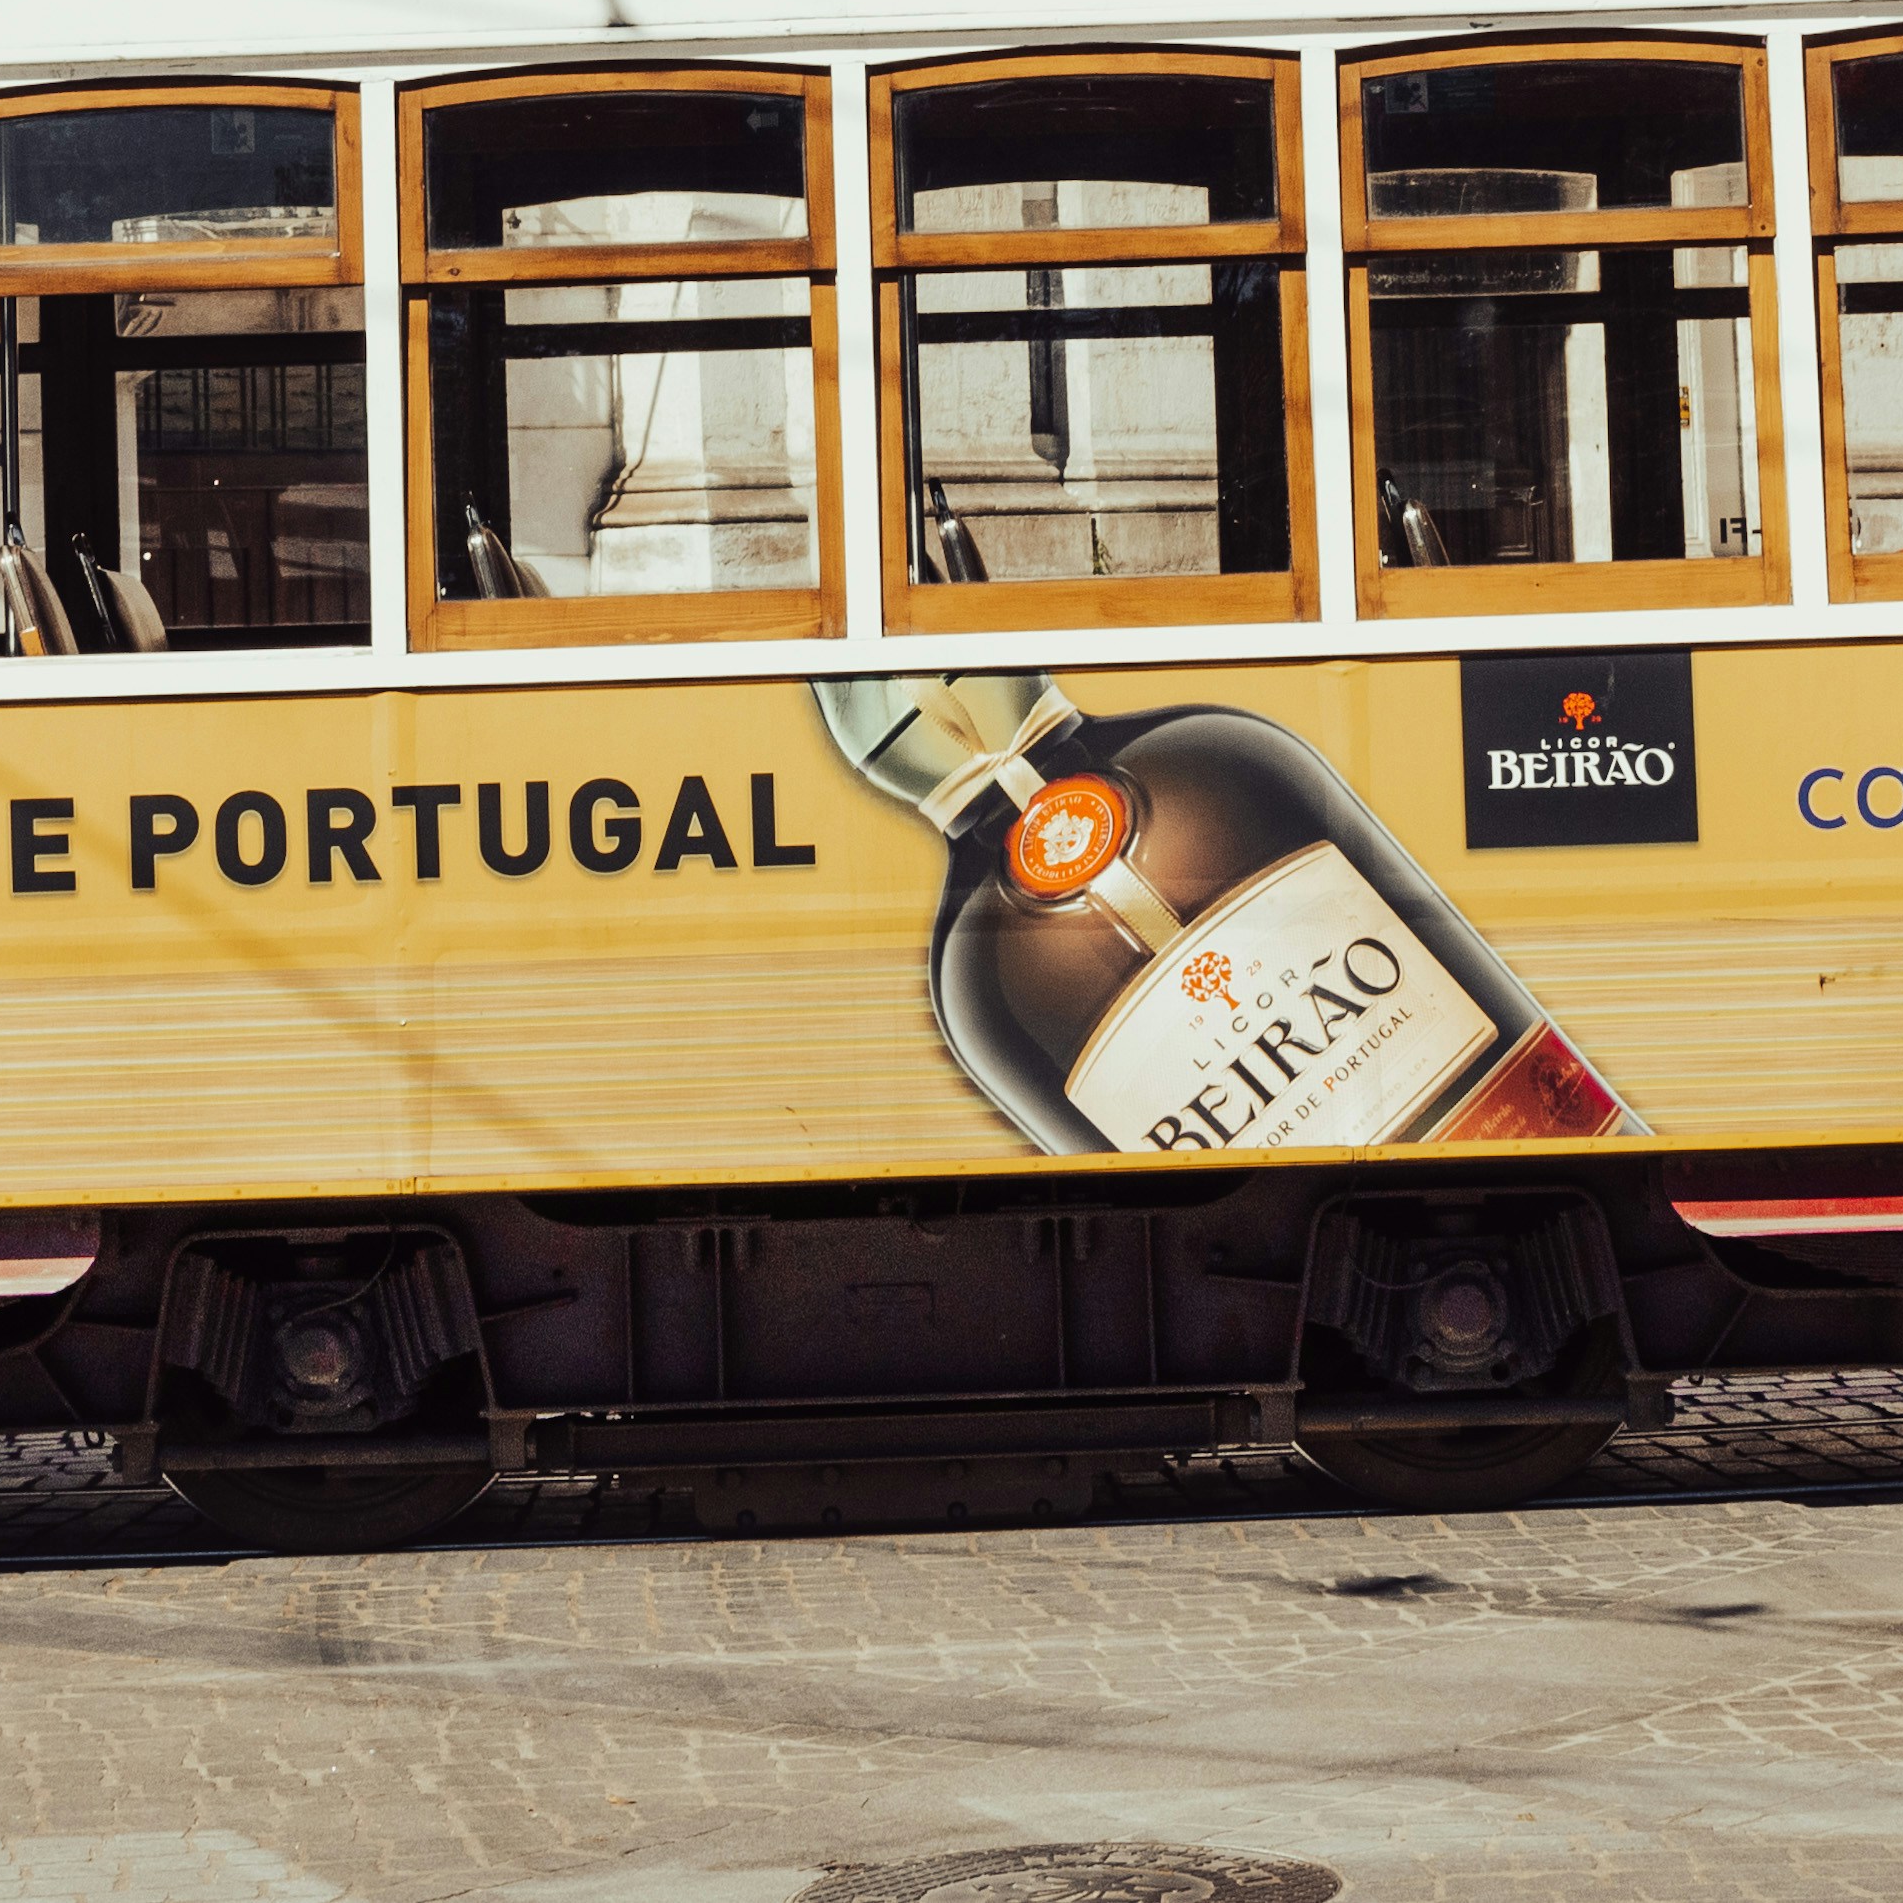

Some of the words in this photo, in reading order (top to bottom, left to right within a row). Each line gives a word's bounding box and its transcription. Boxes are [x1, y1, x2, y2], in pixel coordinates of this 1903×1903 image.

[1486, 742, 1675, 790] BEIRÃO
[1540, 735, 1618, 750] LICOR
[129, 772, 817, 890] PORTUGAL
[1141, 937, 1401, 1151] BEIRÃO
[1189, 1015, 1204, 1031] 19
[1246, 960, 1263, 977] 29
[1193, 968, 1300, 1071] LICOR
[1294, 1092, 1323, 1120] DE
[1323, 1006, 1414, 1094] PORTUGAL
